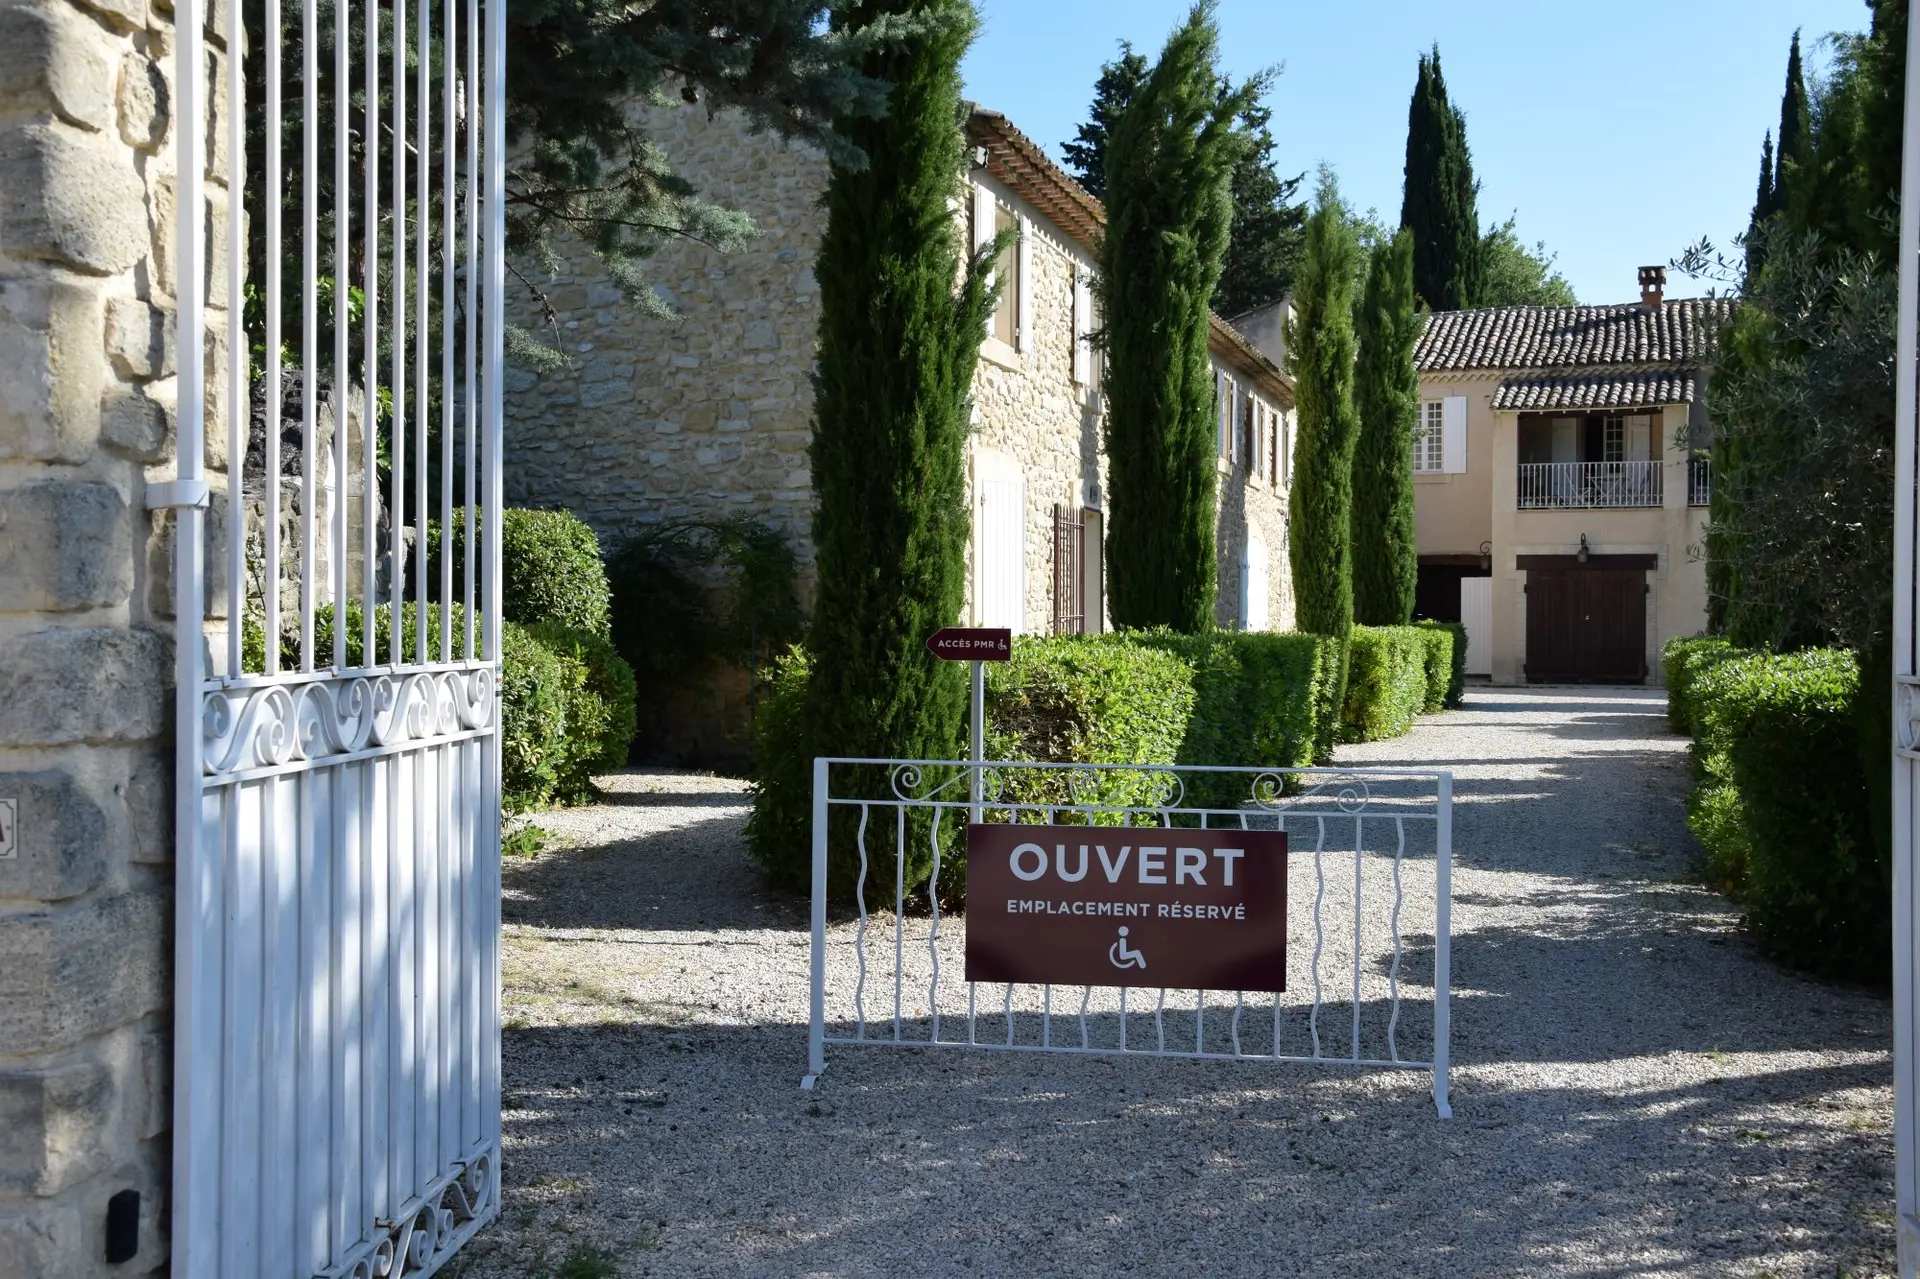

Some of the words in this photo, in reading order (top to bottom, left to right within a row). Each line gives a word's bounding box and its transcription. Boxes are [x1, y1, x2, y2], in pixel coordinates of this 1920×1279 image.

[938, 638, 971, 648] ACCÈS
[974, 640, 995, 648] PMR
[1009, 843, 1245, 886] OUVERT
[1007, 900, 1150, 917] EMPLACEMENT
[1158, 902, 1246, 920] RÉSERVÉ
